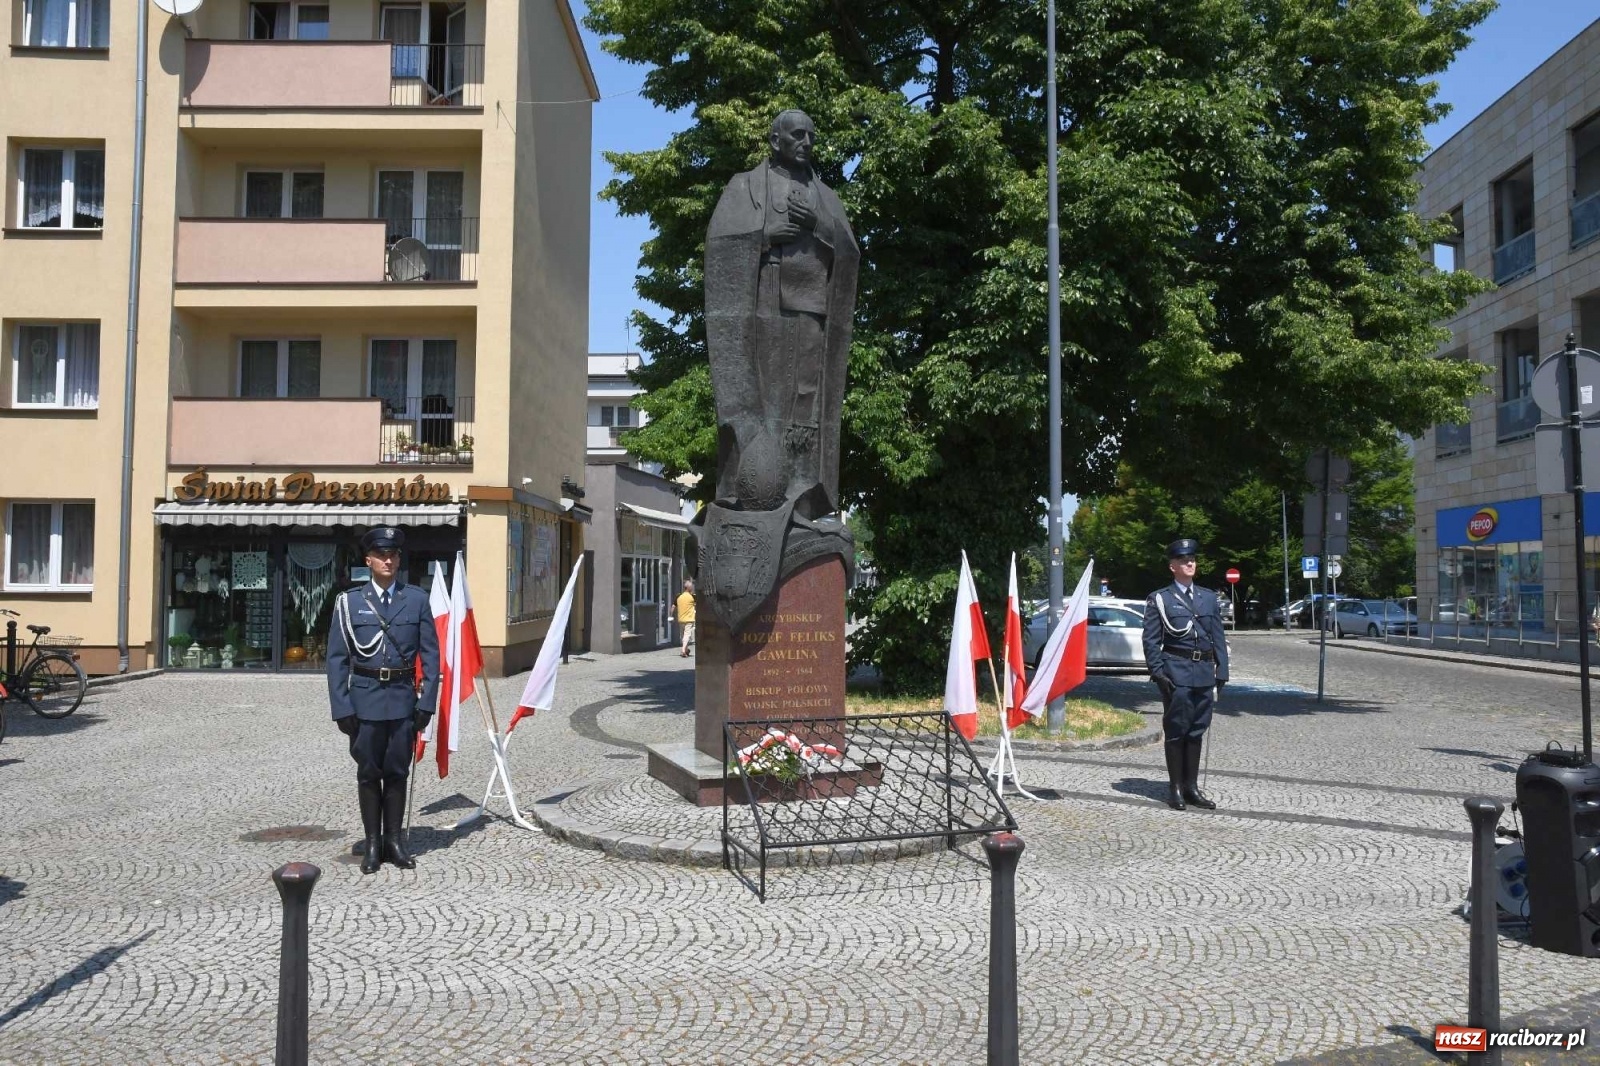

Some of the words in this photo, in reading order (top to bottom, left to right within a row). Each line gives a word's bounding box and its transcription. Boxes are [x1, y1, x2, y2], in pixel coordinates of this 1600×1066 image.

[174, 466, 276, 500] Świat
[282, 471, 449, 500] Prezentów
[1470, 519, 1491, 531] PEPCO
[760, 613, 822, 623] ARCYBISKUP
[790, 631, 836, 643] FELIKS
[756, 649, 818, 661] GAWLINA
[745, 687, 781, 696] BISKUP
[787, 685, 828, 695] POLOWY
[743, 701, 778, 709] WOJSK
[782, 698, 832, 709] POLSKICH
